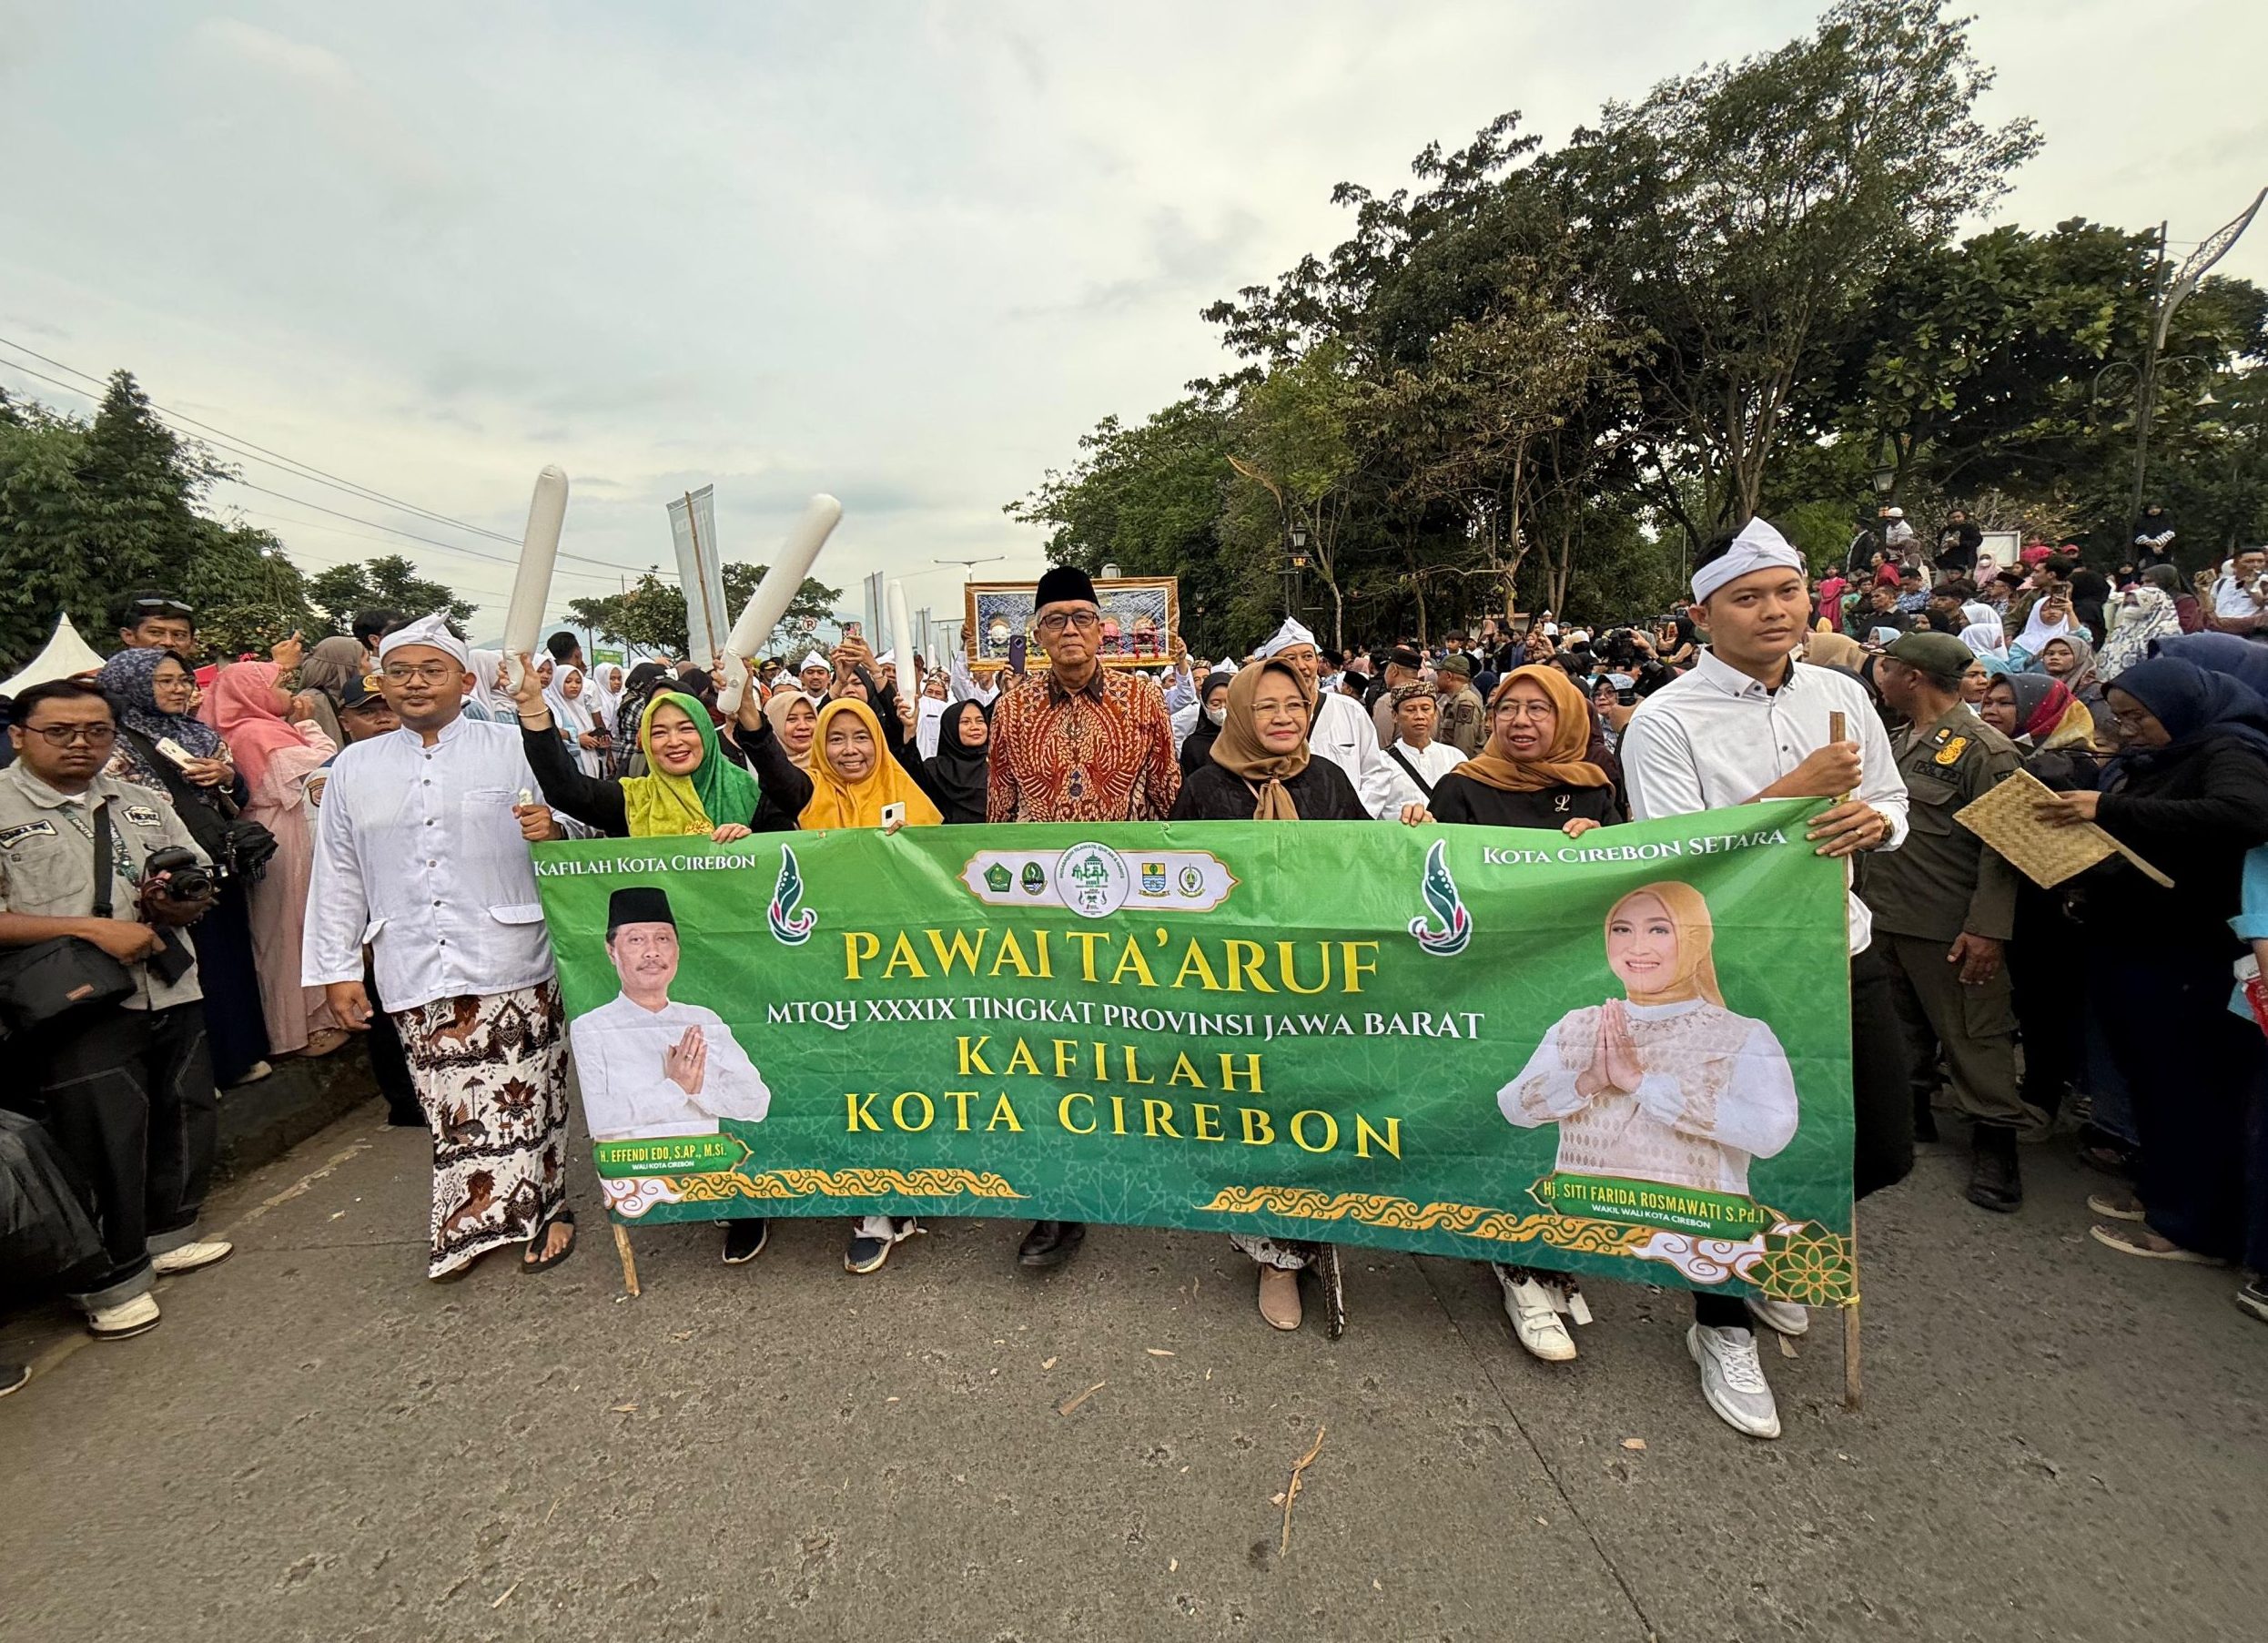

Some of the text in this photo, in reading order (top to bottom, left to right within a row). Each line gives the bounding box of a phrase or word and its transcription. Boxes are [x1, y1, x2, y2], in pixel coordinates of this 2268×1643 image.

[1688, 829, 1787, 856] SETARA
[842, 927, 1380, 994] PAWAI TA'ARUF
[766, 997, 1485, 1041] MTQH XXXIX TINGKAT PROVINSI JAWA BARAT
[957, 1036, 1266, 1093] KAFILAH
[844, 1091, 1402, 1161] KOTA CIREBON
[600, 1150, 609, 1162] H.
[612, 1148, 649, 1162] EFFENDI
[652, 1146, 672, 1161] EDO,
[704, 1143, 727, 1157] M.Si.
[667, 1161, 694, 1169] CIREBON
[1544, 1182, 1765, 1224] Hj. SITI FARIDA ROSMAWATI S.Pd.I
[1592, 1203, 1711, 1229] WAKIL WALI KOTA CIREBON
